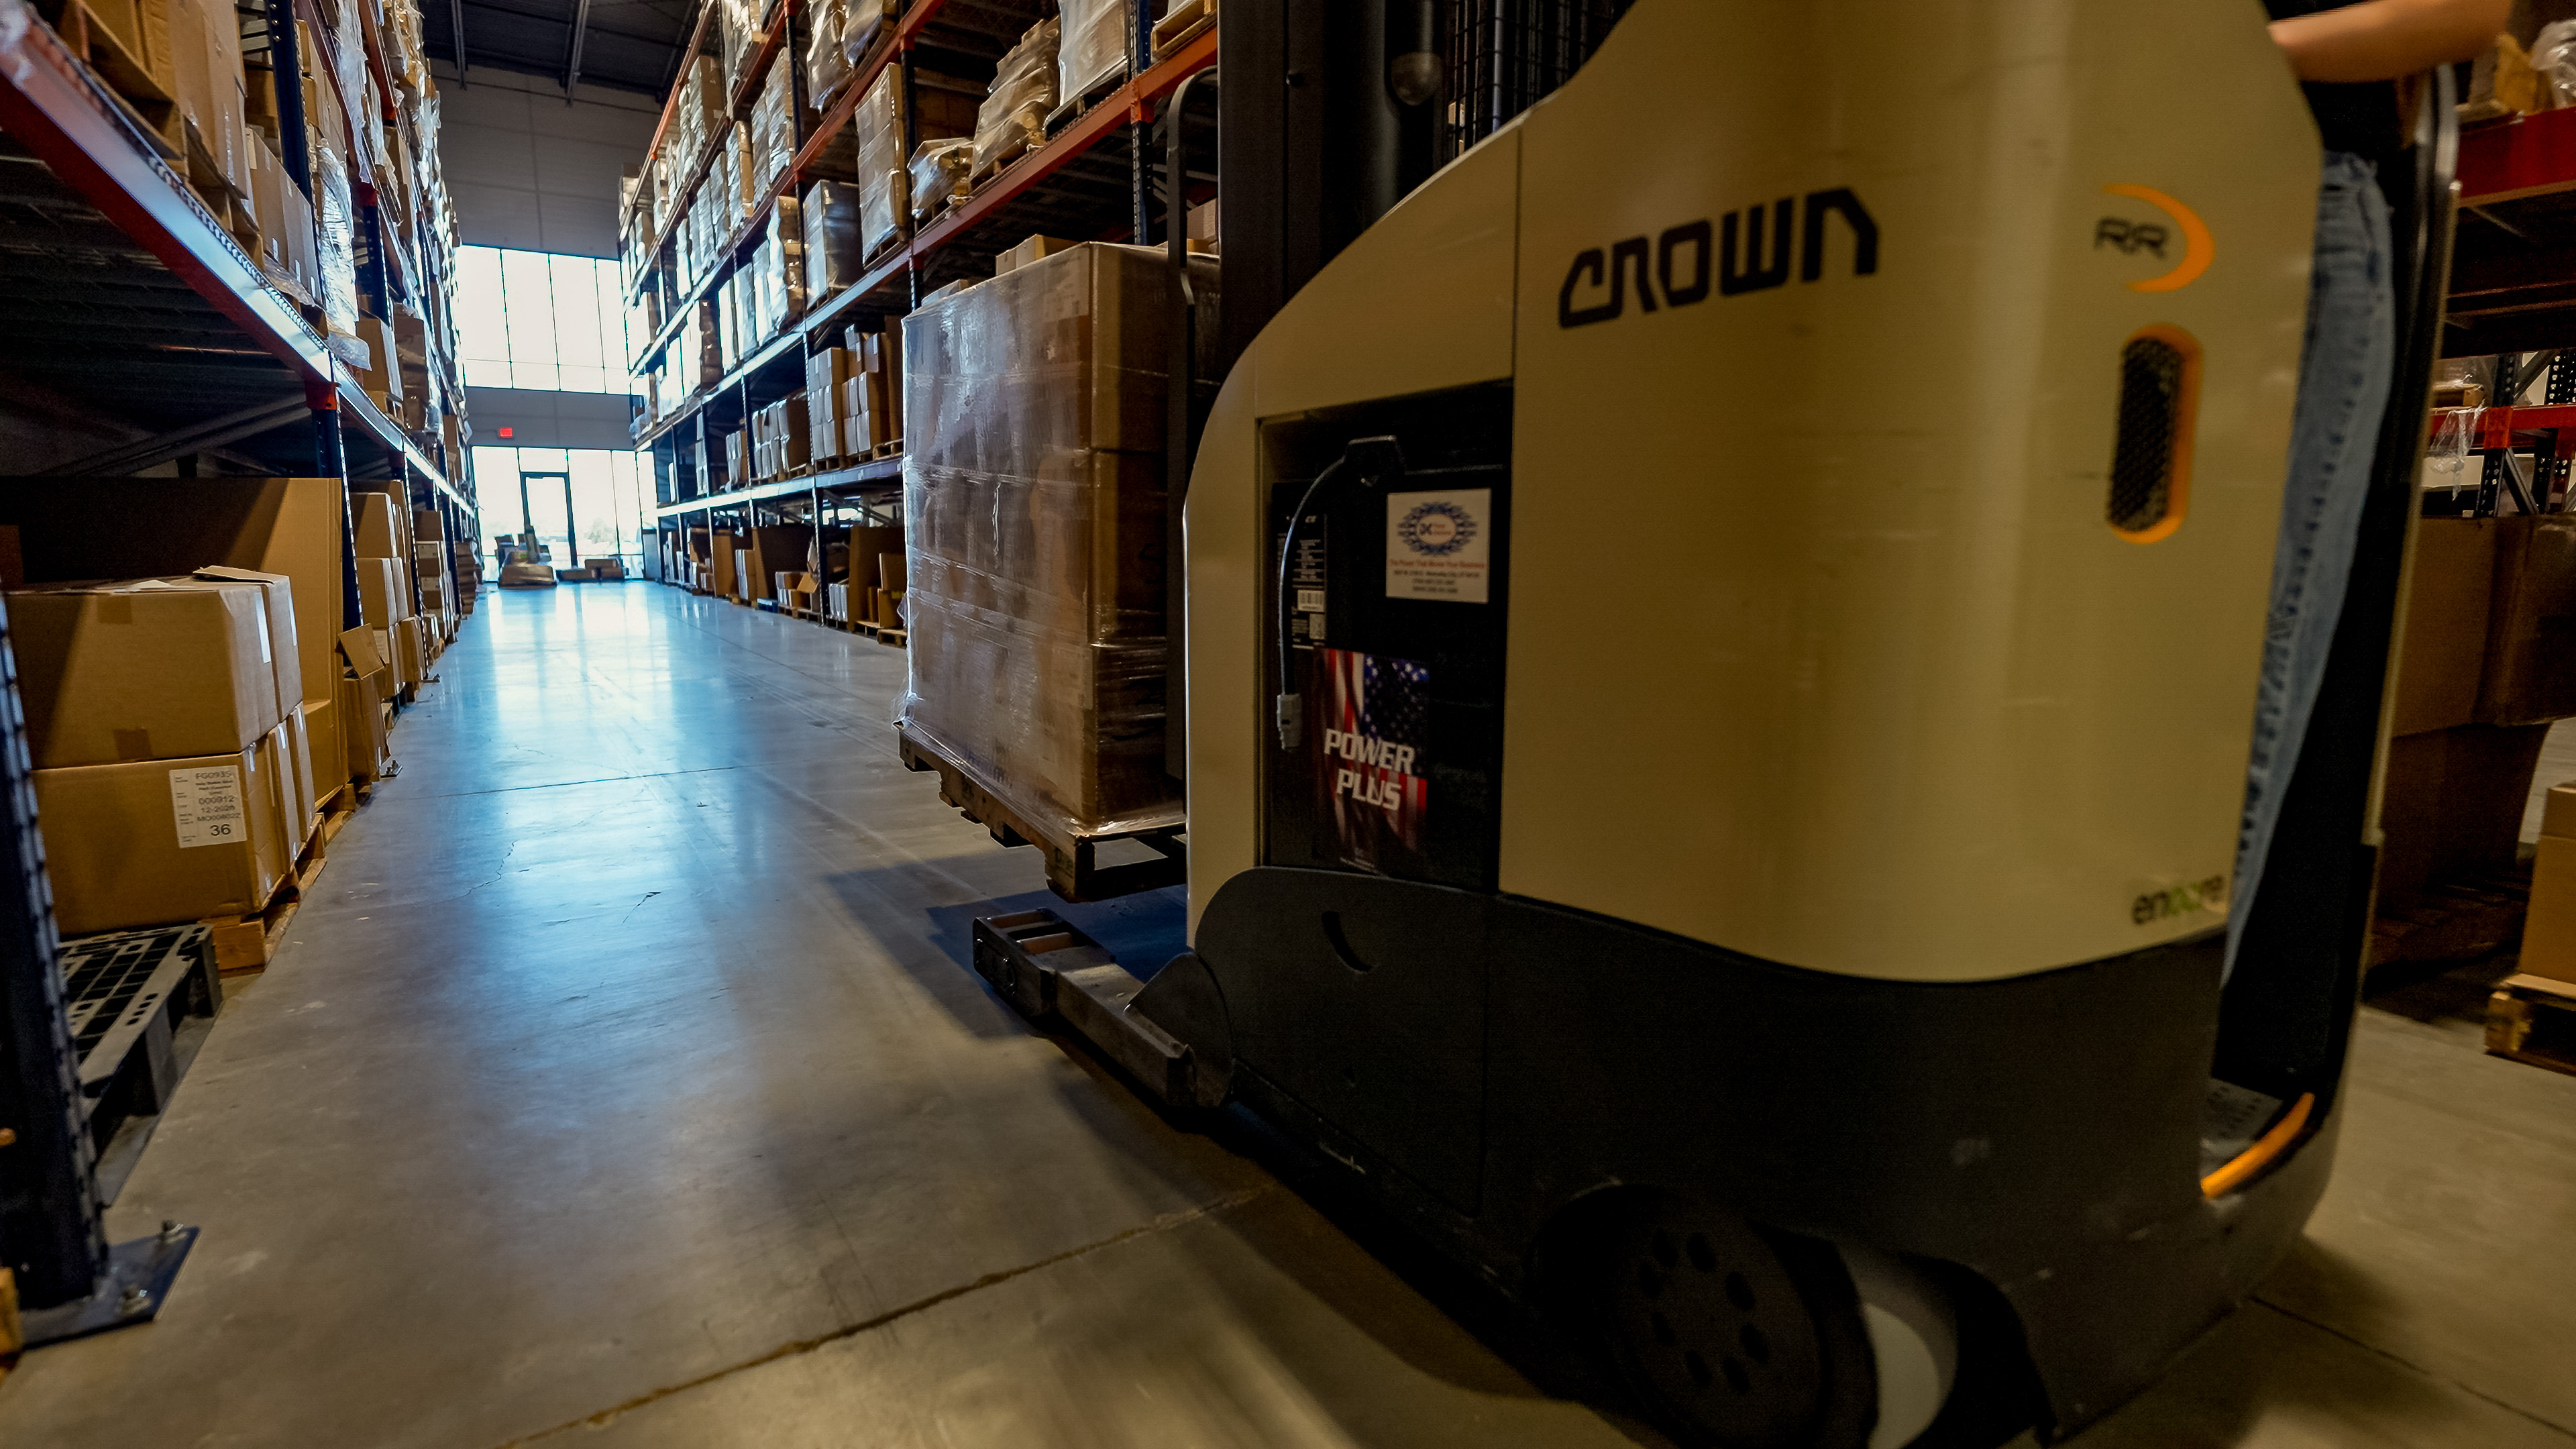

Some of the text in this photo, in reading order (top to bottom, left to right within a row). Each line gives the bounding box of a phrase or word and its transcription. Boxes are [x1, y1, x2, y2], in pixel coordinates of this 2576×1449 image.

[1558, 186, 1879, 329] CROWN
[1324, 728, 1415, 775] POWER
[1336, 768, 1401, 811] PLUS
[210, 824, 231, 836] 36
